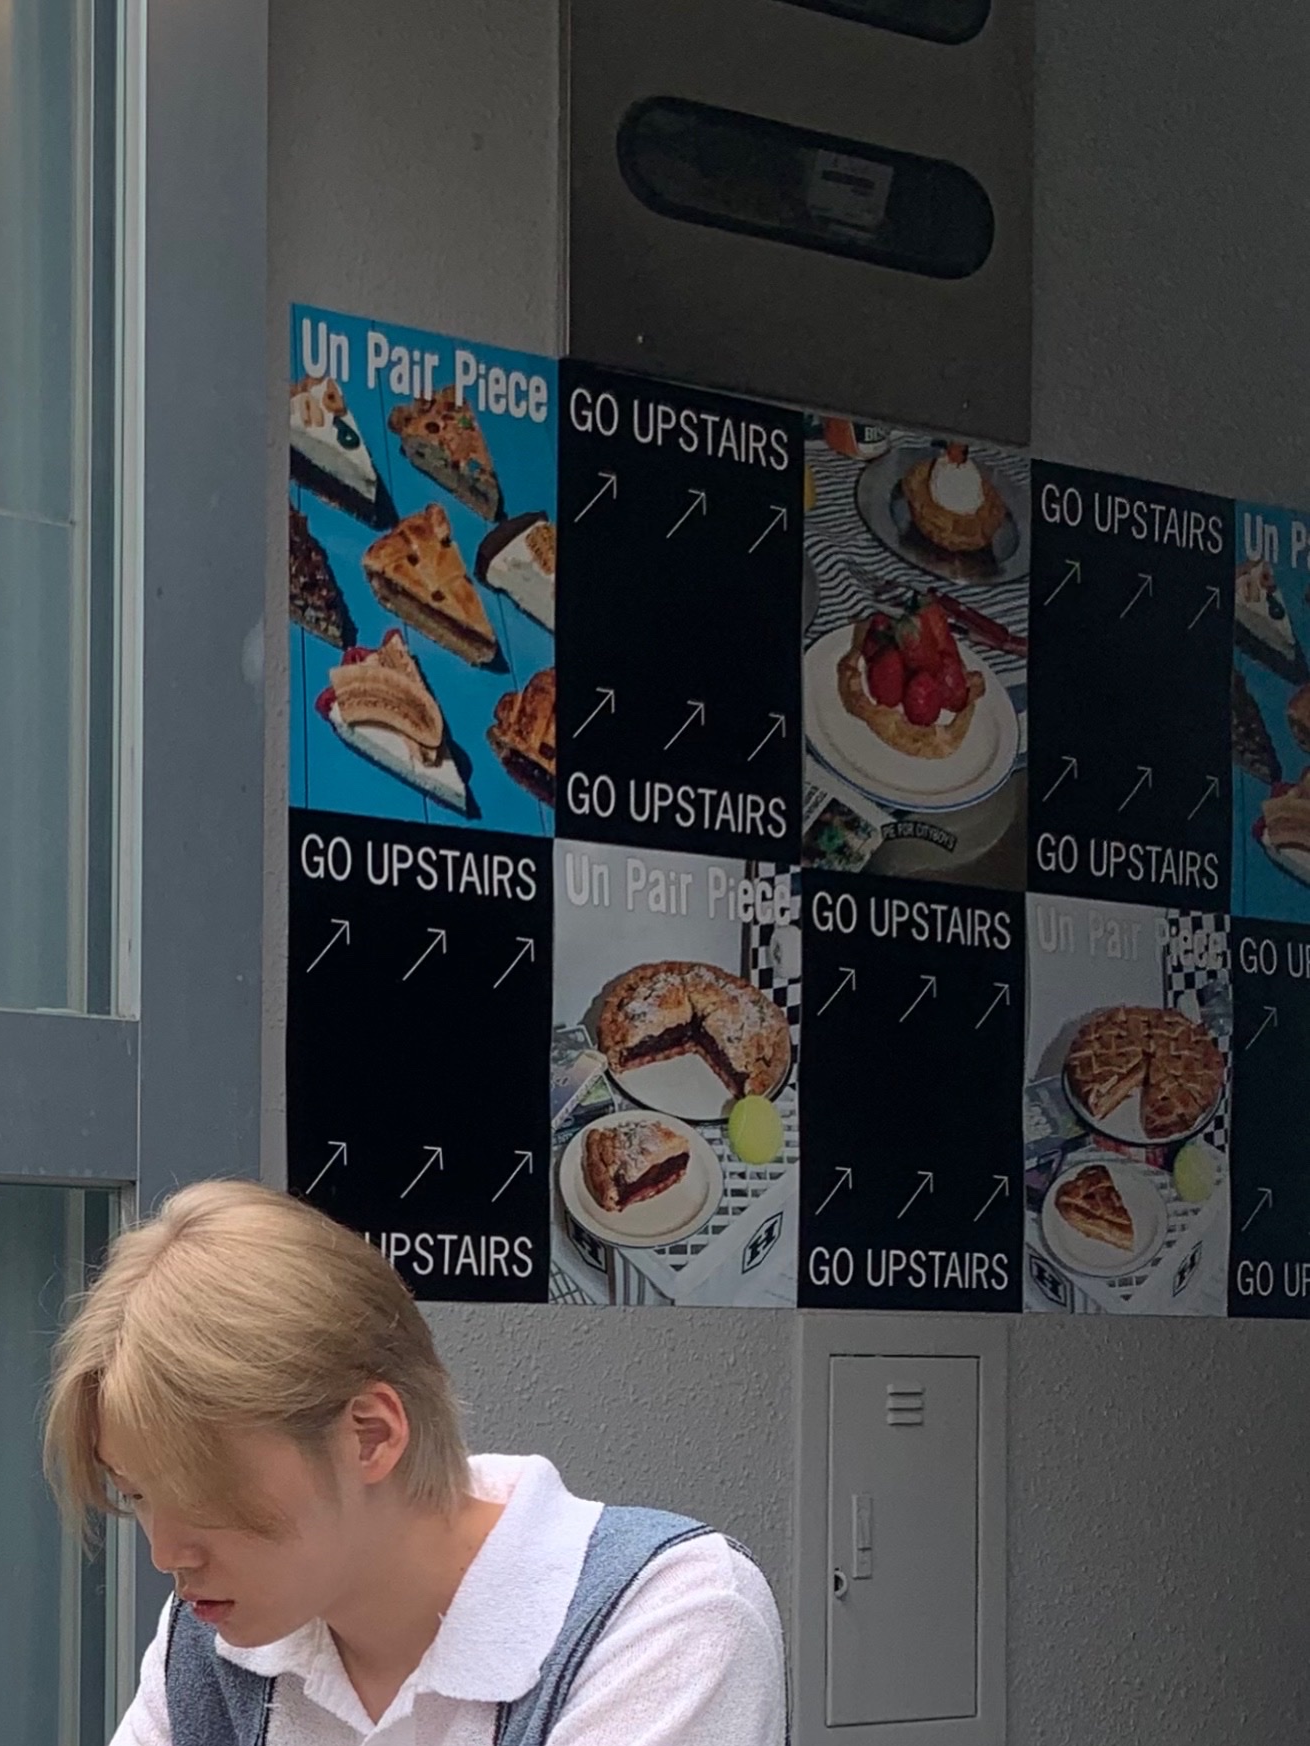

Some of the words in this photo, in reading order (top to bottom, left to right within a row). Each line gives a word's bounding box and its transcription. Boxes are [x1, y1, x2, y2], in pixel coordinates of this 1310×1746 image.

[302, 318, 349, 381] Un
[367, 330, 438, 401] Pair
[455, 350, 548, 423] Piece
[570, 387, 618, 438] GO
[633, 398, 788, 471] UPSTAIRS
[1041, 484, 1083, 527] GO
[1094, 491, 1224, 554] UPSTAIRS
[1243, 512, 1279, 563] Un
[1291, 521, 1310, 570] P
[567, 771, 615, 819] GO
[630, 778, 787, 839] UPSTAIRS
[301, 833, 351, 881] GO
[367, 841, 537, 901] UPSTAIRS
[565, 853, 610, 907] Un
[627, 858, 692, 915] Pair
[708, 865, 789, 925] Piece
[1037, 832, 1078, 873] GO
[1091, 837, 1219, 890] UPSTAIRS
[812, 891, 857, 934] GO
[869, 896, 1011, 950] UPSTAIRS
[1036, 906, 1074, 952] Un
[1091, 913, 1142, 962] Pair
[1156, 918, 1230, 968] Piece
[1239, 937, 1278, 974] GO
[809, 1246, 853, 1287] GO
[867, 1250, 1009, 1290] UPSTAIRS
[1237, 1261, 1275, 1296] GO
